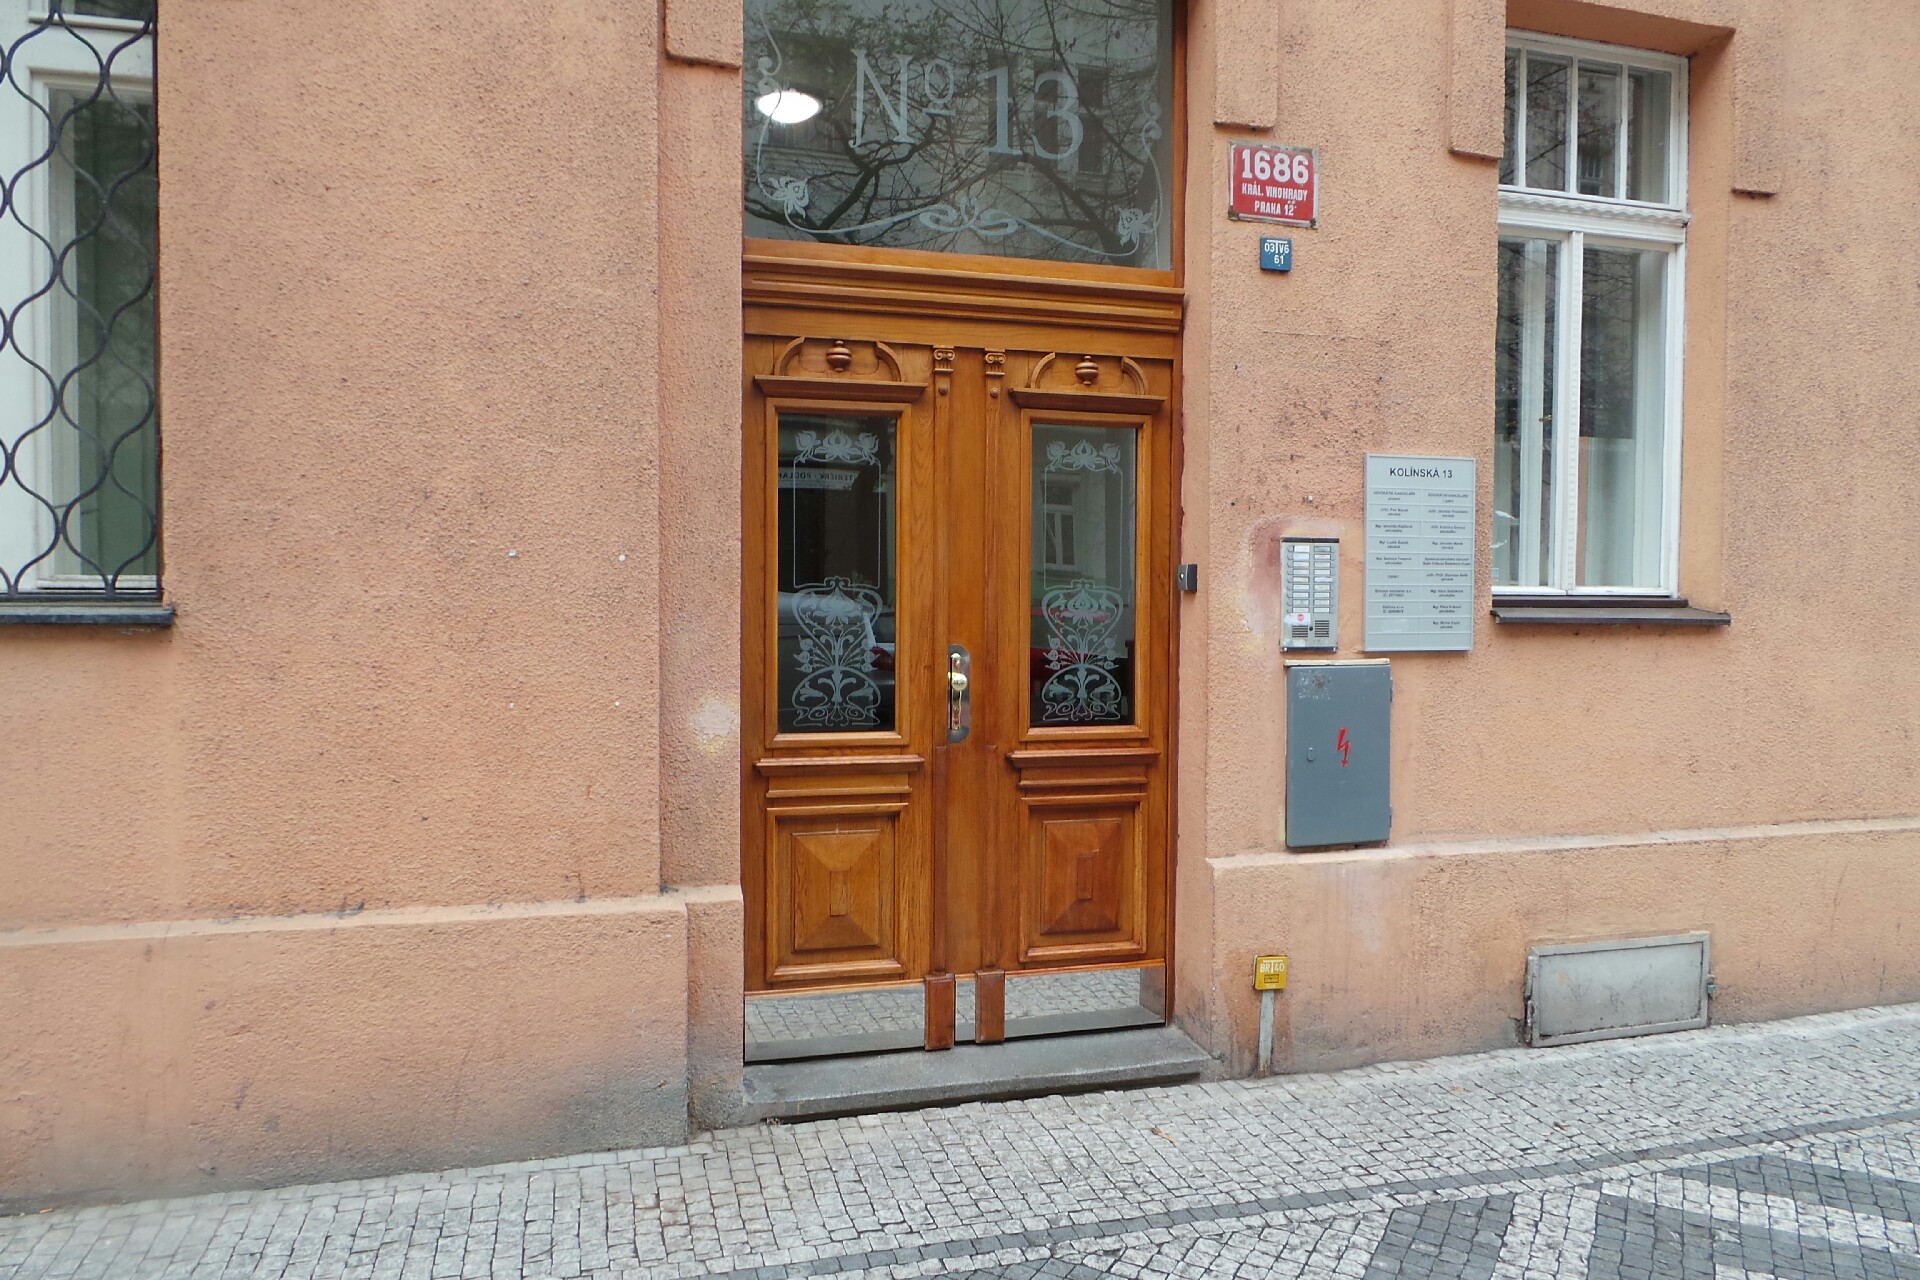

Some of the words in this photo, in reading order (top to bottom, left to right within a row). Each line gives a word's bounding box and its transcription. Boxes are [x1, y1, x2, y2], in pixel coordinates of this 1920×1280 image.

[977, 66, 1085, 160] 13
[1242, 149, 1309, 184] 1686
[1241, 181, 1264, 197] KRÁL.
[1265, 186, 1308, 202] VINOHRADY
[1254, 200, 1281, 215] PRAHA
[1274, 255, 1284, 265] 61
[1389, 466, 1440, 479] KOLÍNSKÁ
[1442, 469, 1453, 479] 13
